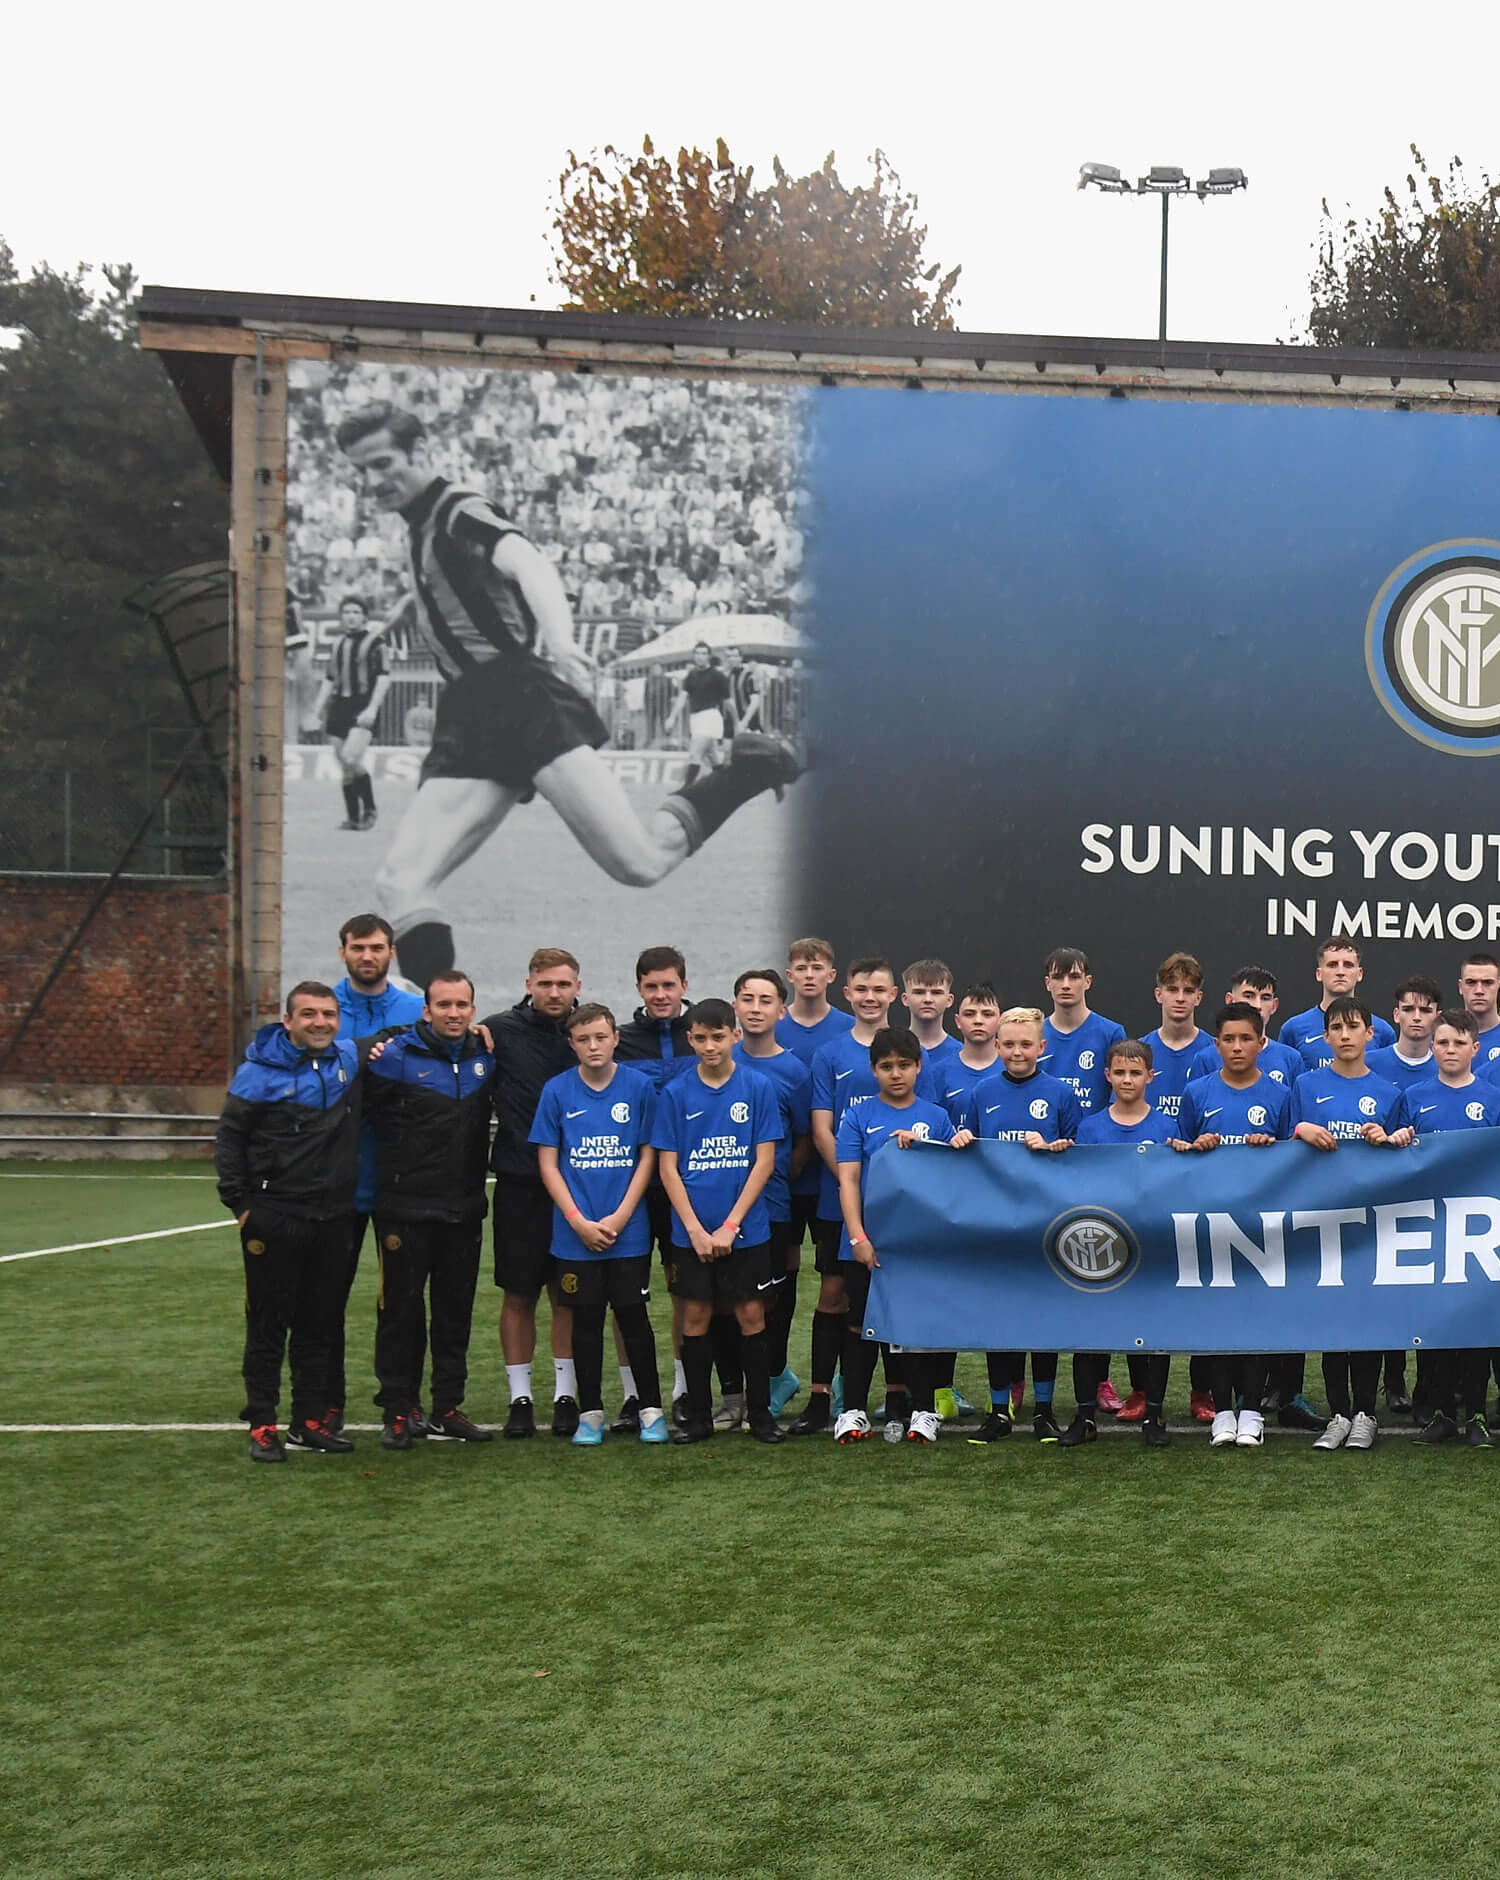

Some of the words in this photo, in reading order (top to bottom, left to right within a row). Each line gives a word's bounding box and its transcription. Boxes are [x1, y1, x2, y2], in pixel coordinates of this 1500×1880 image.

[1080, 823, 1334, 878] SUNING
[1267, 898, 1316, 937] IN
[1327, 1120, 1362, 1133] INTER
[582, 1135, 620, 1147] INTER
[701, 1135, 737, 1148] INTER
[570, 1145, 632, 1159] ACADEMY
[689, 1145, 749, 1160] ACADEMY
[569, 1156, 634, 1170] Experience
[687, 1157, 750, 1172] Experience
